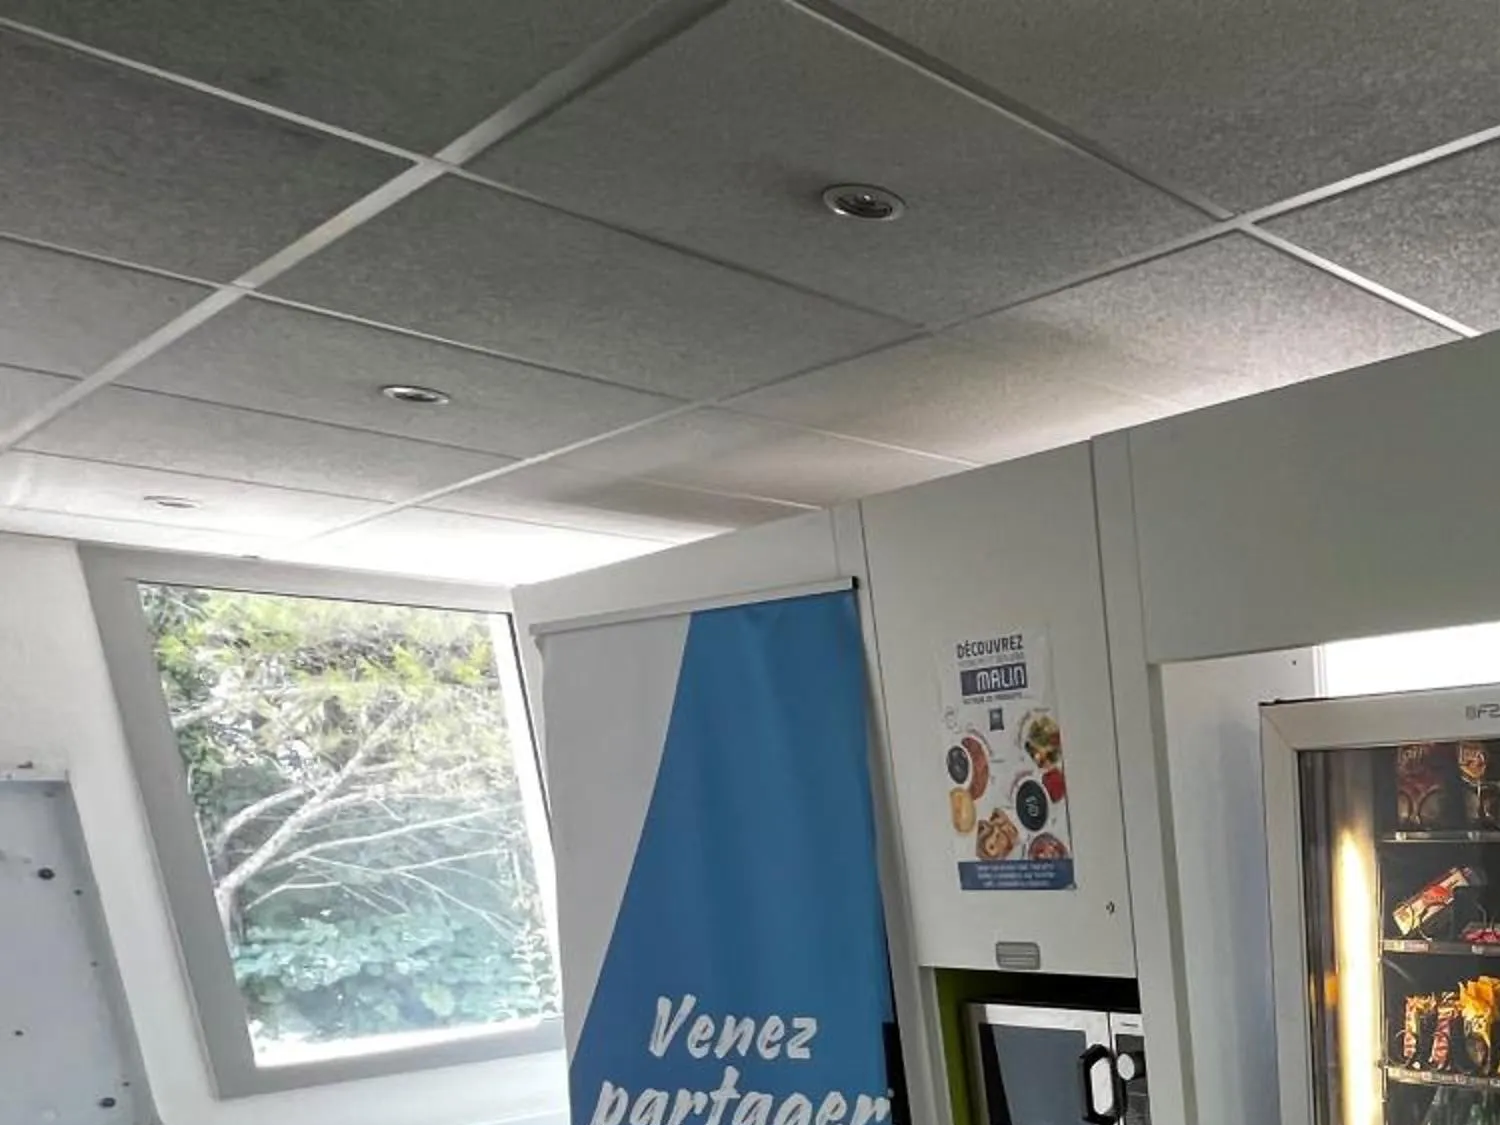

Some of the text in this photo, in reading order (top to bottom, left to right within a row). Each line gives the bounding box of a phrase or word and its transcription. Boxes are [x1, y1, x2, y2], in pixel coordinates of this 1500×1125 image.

[956, 634, 1025, 660] DÉCOUVREZ
[976, 665, 1026, 692] MALIN
[648, 993, 818, 1060] Venez
